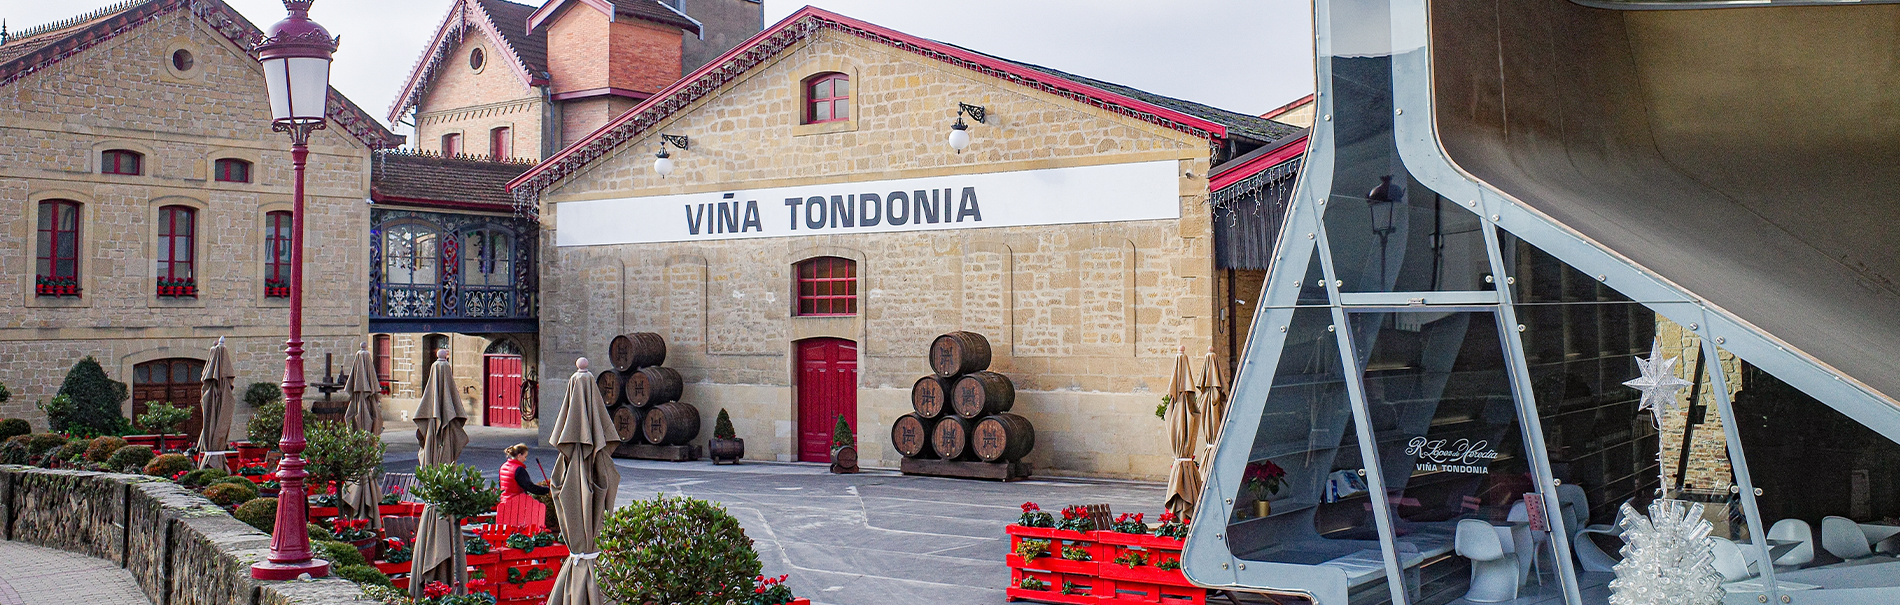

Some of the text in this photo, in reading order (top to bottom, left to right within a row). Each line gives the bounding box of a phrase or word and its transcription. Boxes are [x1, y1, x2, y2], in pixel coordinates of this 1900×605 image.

[685, 186, 983, 235] VIÑA TONDONIA
[1416, 461, 1489, 475] VIÑA TONDONIA
